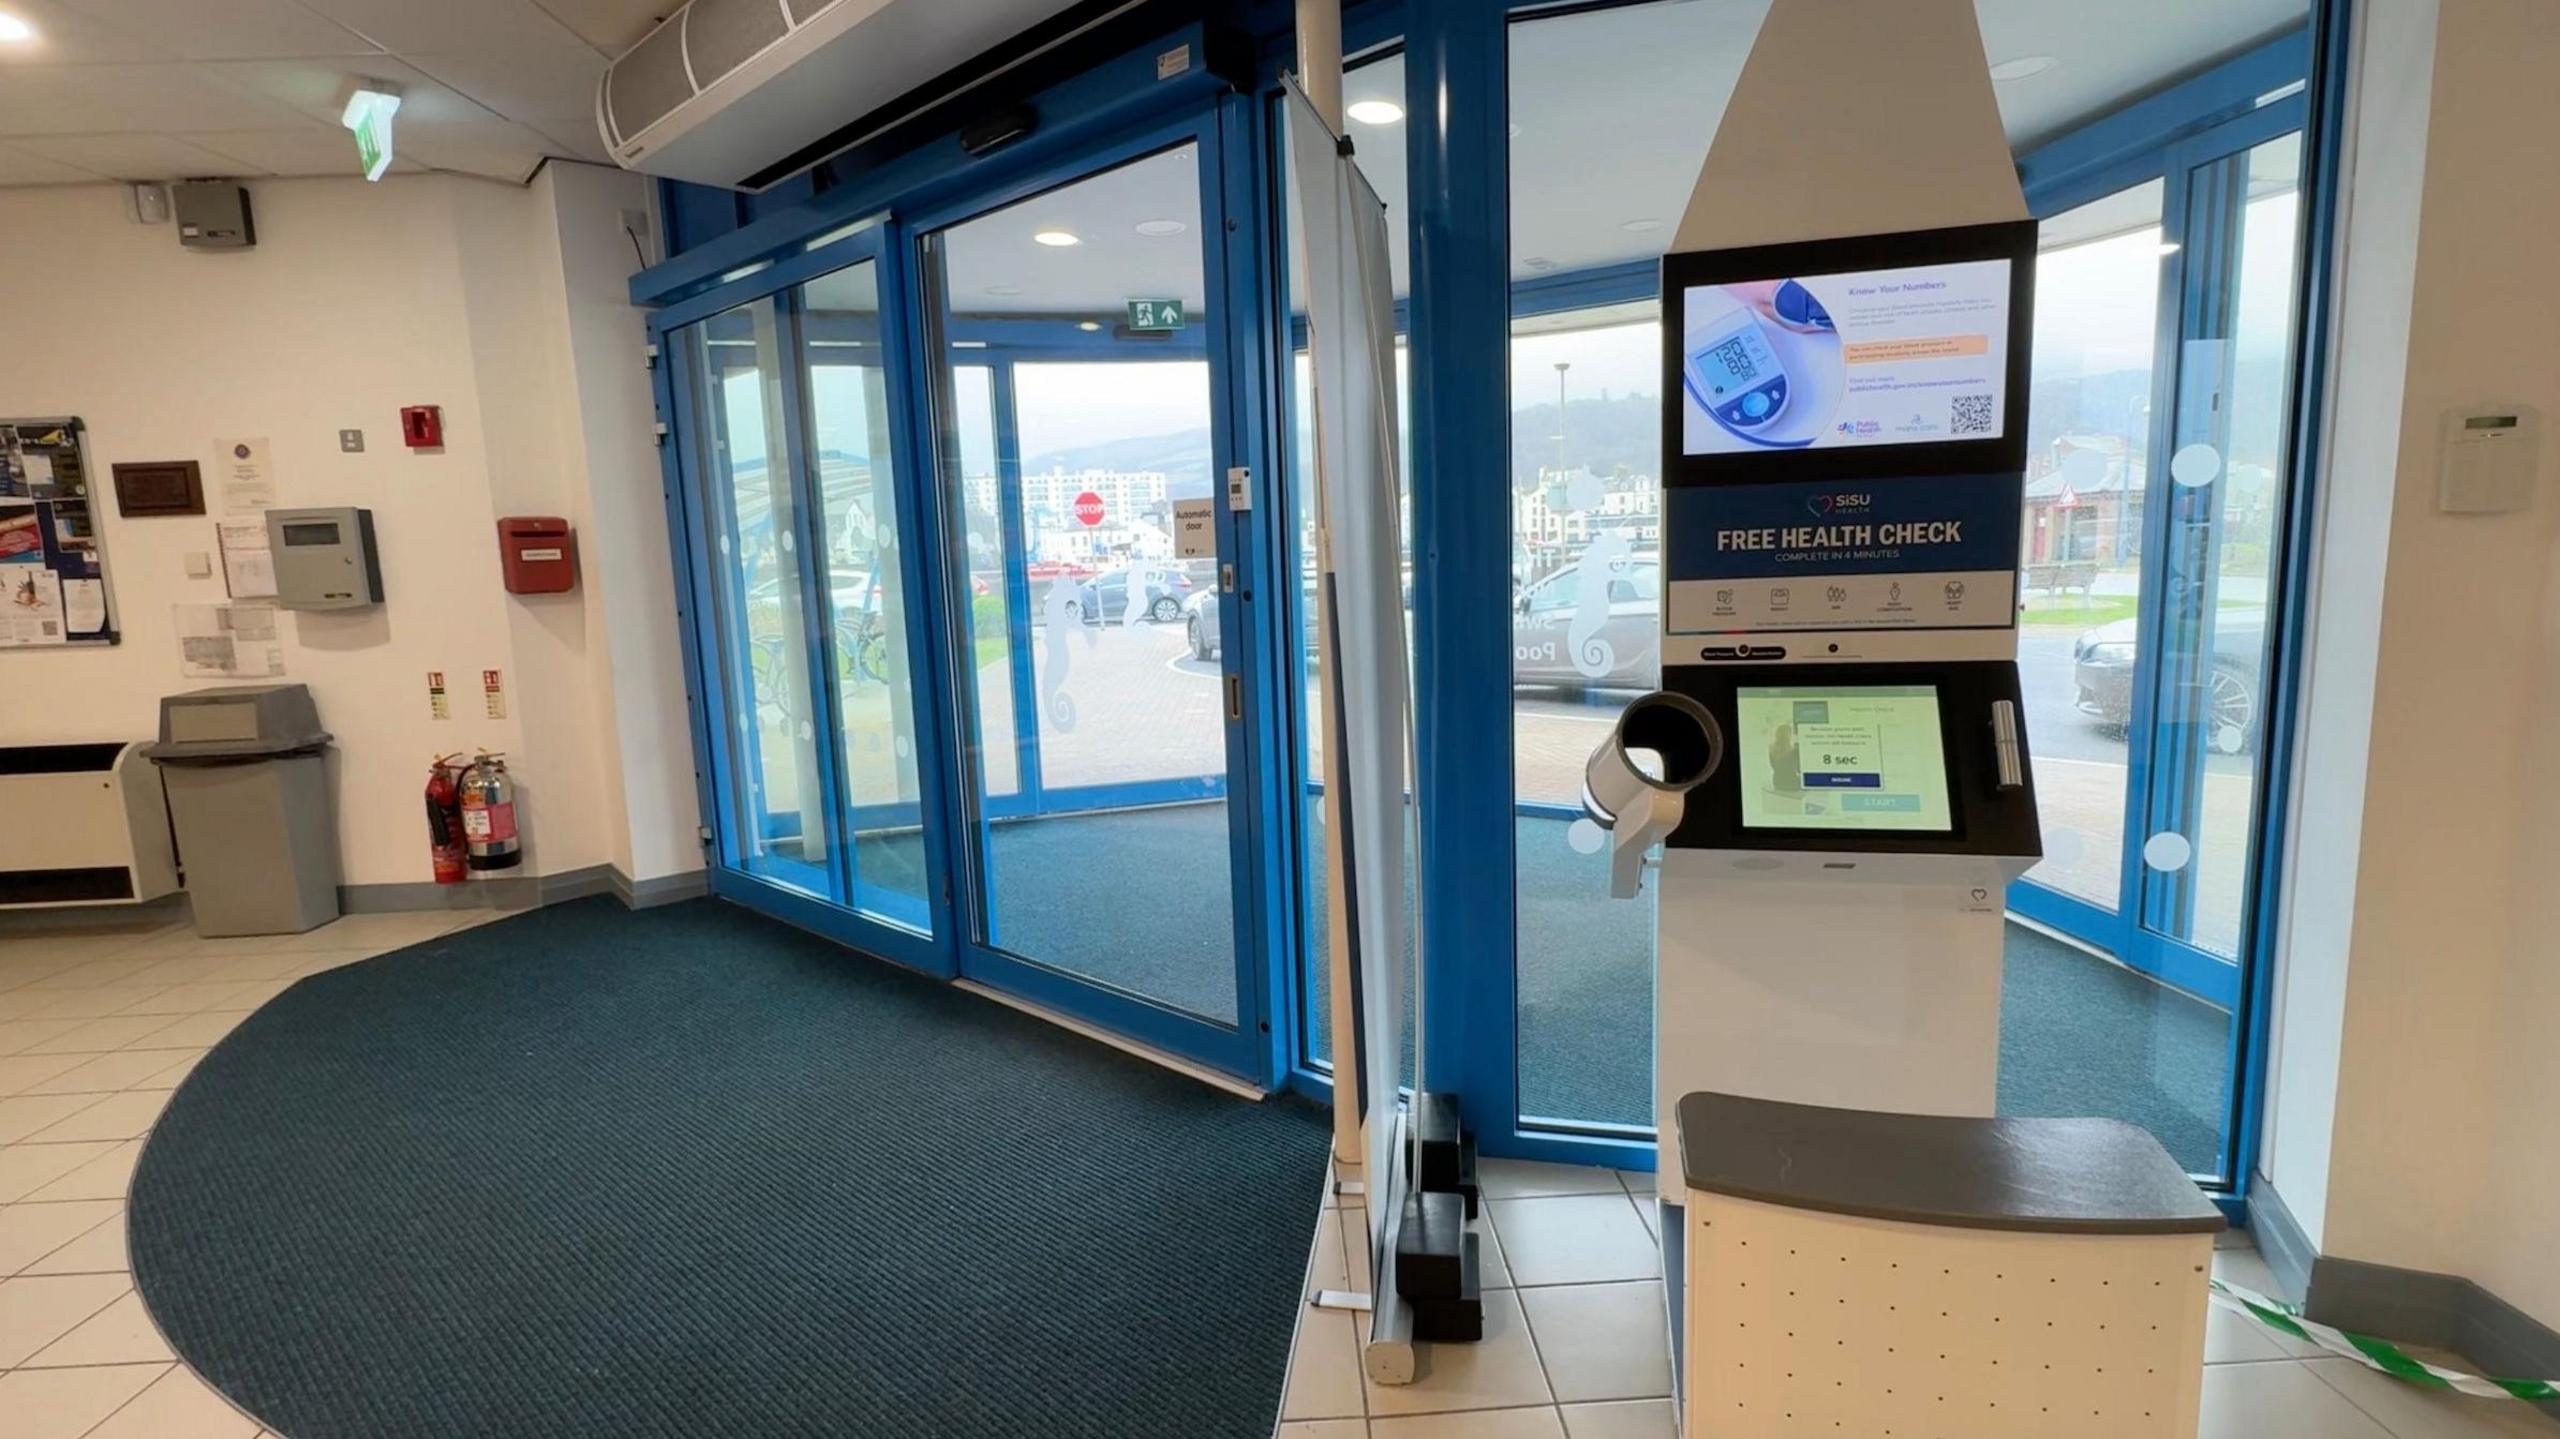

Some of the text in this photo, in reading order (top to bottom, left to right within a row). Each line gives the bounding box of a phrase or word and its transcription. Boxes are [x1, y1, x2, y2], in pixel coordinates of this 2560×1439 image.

[1848, 281, 1947, 296] Know Your Numbers
[1076, 504, 1104, 515] STOP
[1176, 509, 1212, 519] Automatic
[1185, 522, 1203, 531] door
[1717, 521, 1962, 551] FREE HEALTH CHECK
[1775, 549, 1900, 562] COMPLETE IN 4 MINUTES
[1822, 754, 1858, 765] 8 sec
